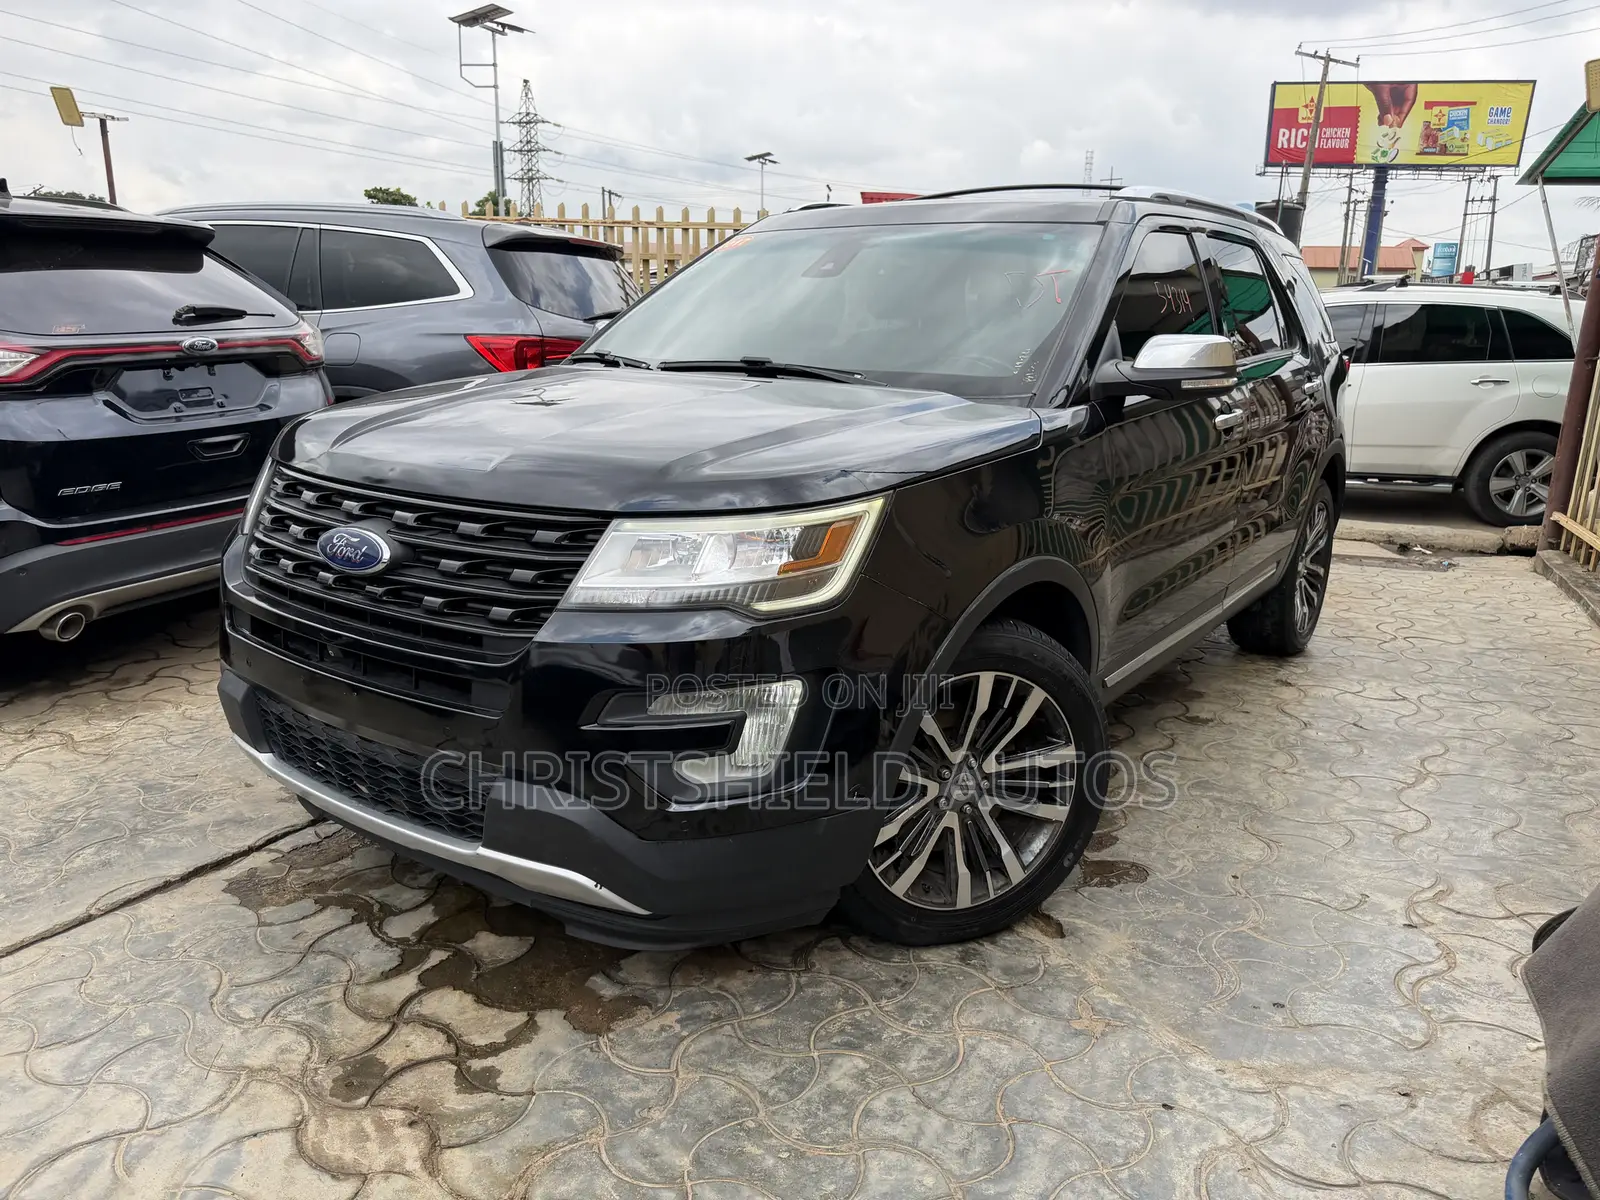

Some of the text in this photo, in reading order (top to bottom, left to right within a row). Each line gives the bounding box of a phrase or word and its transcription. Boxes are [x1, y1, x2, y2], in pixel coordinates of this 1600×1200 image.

[1321, 127, 1351, 138] CHICKEN
[1320, 138, 1350, 149] FLAVOUR
[57, 481, 122, 497] EDGE
[326, 532, 368, 563] Ford
